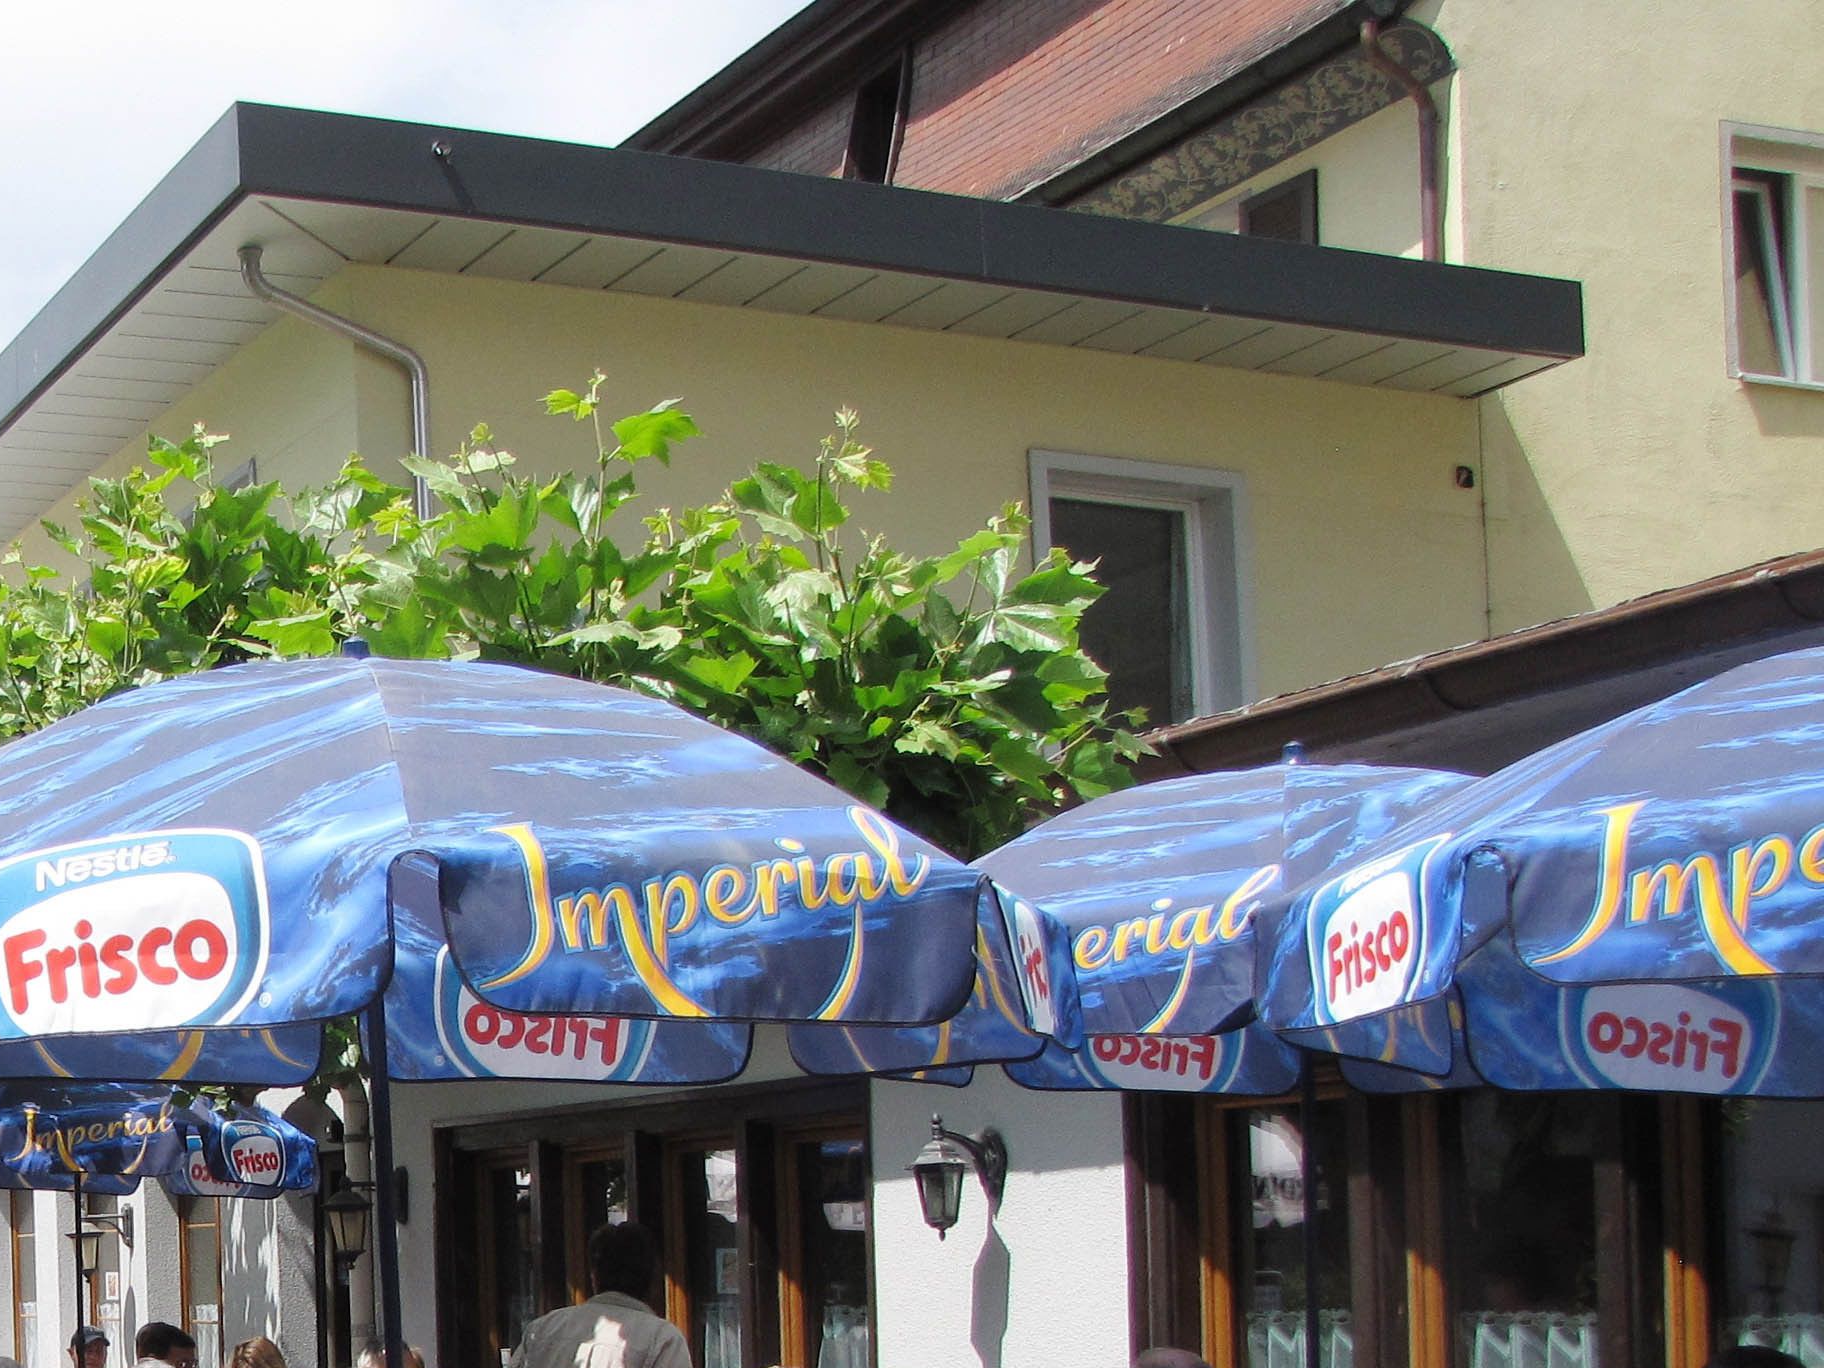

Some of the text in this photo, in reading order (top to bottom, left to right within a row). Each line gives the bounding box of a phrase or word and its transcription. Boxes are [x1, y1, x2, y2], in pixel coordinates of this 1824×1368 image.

[34, 842, 174, 893] Nestlé
[478, 804, 931, 1019] Imperial
[1530, 799, 1824, 976] Impe
[2, 917, 229, 1016] Frisco
[1074, 863, 1280, 1034] erial
[1327, 910, 1409, 1005] Frisco
[6, 1101, 175, 1174] Imperial
[232, 1148, 279, 1174] Frisco
